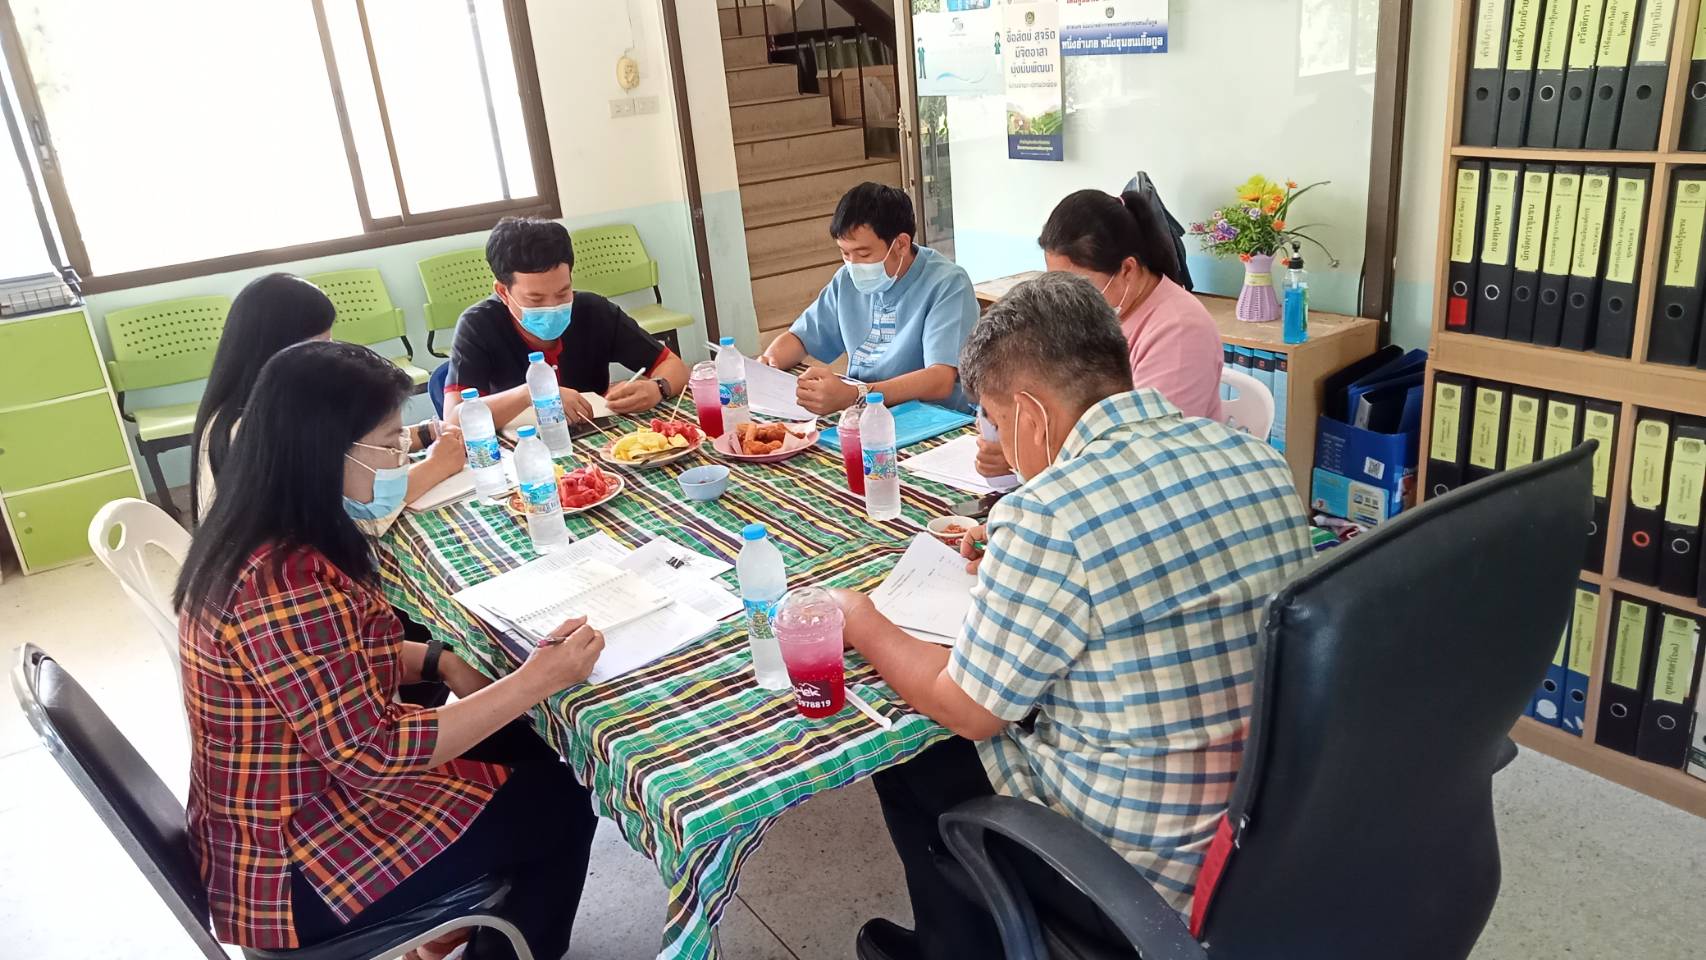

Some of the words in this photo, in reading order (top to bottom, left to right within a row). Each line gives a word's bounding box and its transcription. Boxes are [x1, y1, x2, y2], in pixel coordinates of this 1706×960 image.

[1578, 4, 1592, 44] สวัสดิการ
[1034, 27, 1056, 44] สุจริต
[1015, 46, 1048, 58] มีจิตอาสา
[1010, 60, 1054, 77] มุ่งมั่นพัฒนา
